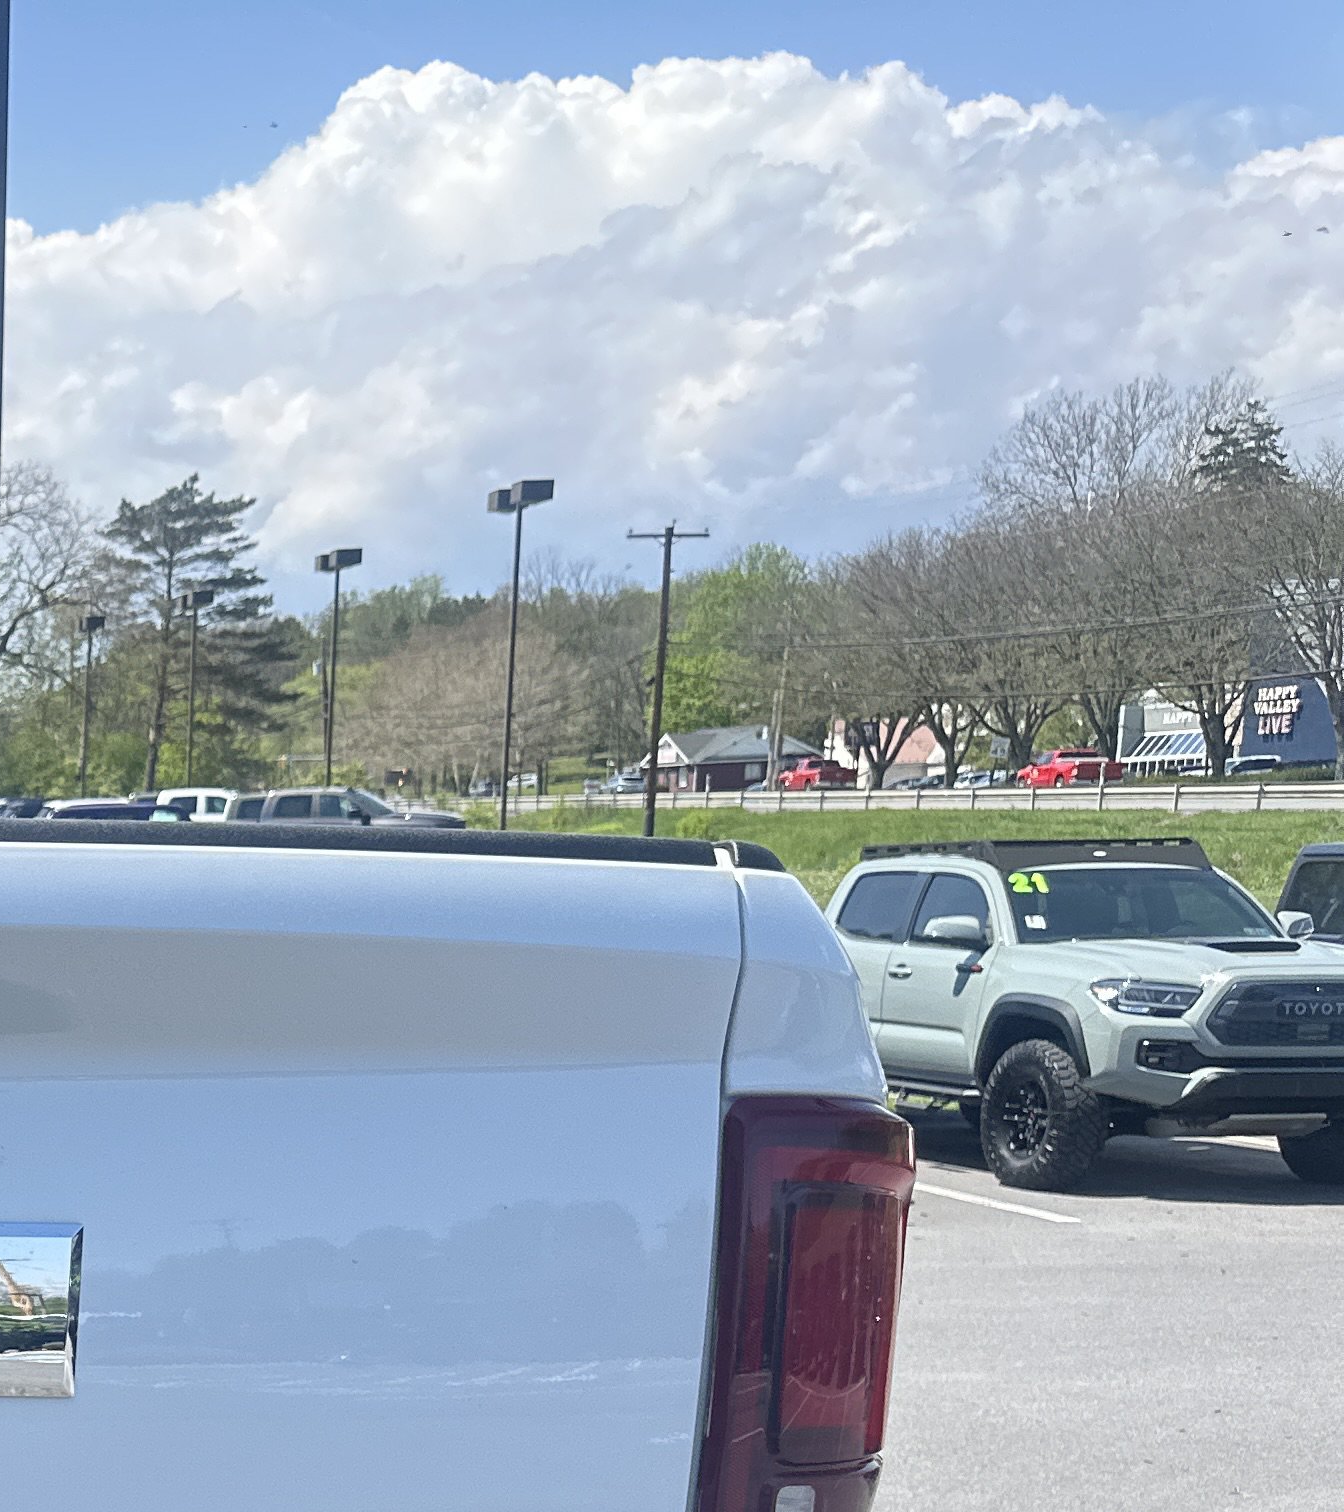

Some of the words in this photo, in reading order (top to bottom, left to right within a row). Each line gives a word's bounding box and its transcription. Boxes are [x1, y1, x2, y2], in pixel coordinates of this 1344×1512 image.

[1257, 685, 1298, 701] HAPPY
[1253, 699, 1300, 715] VALLEY
[1257, 714, 1293, 735] LIVE
[1008, 872, 1049, 893] 21
